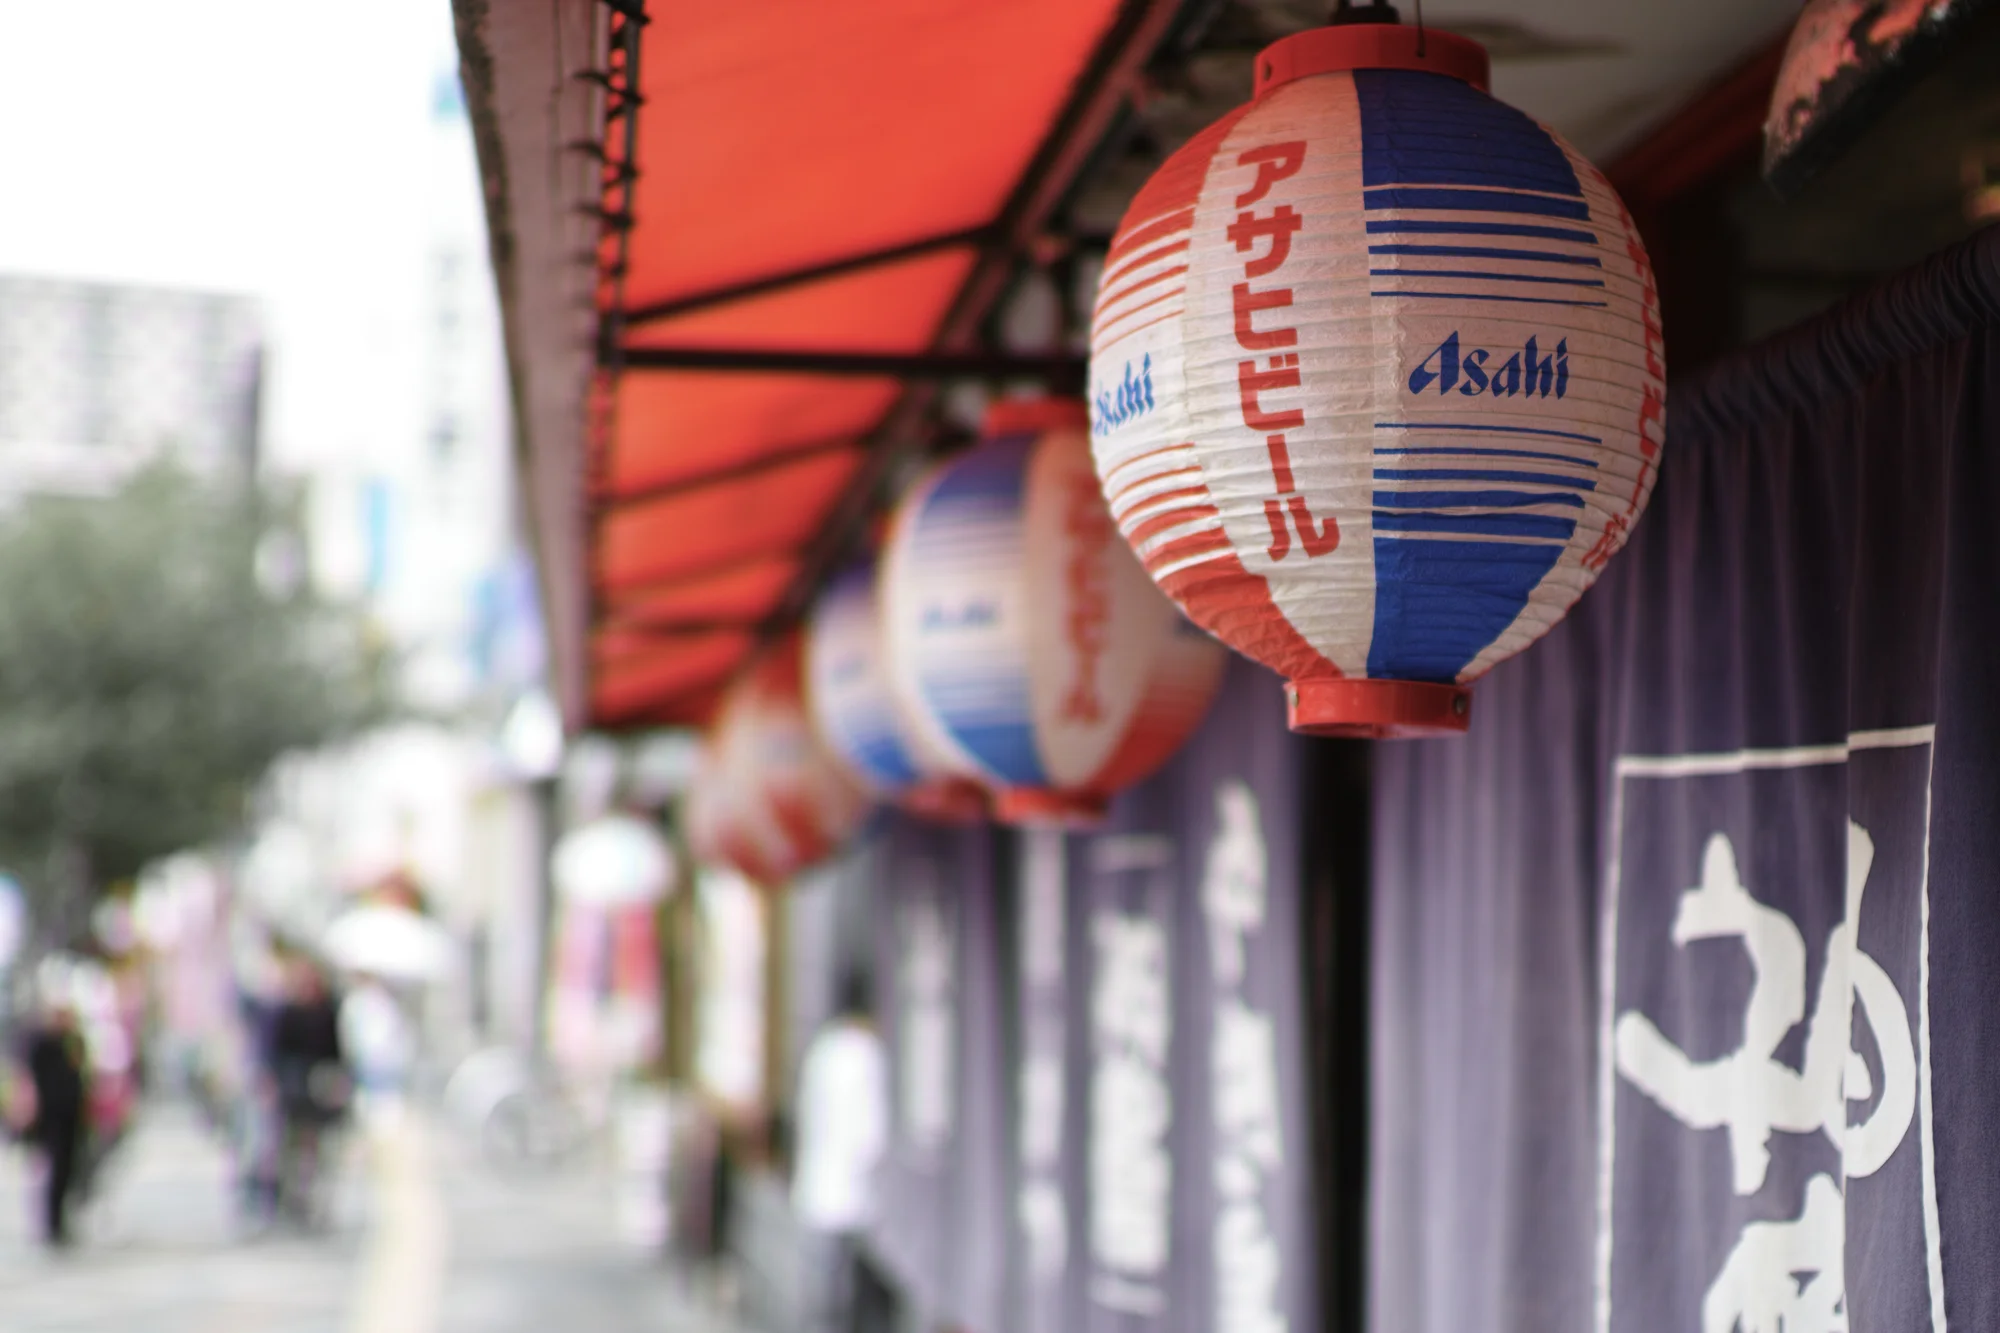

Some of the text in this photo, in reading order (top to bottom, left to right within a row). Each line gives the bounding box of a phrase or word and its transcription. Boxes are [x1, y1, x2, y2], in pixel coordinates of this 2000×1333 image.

[1227, 140, 1340, 562] アサヒビール
[1408, 330, 1569, 400] Asahi
